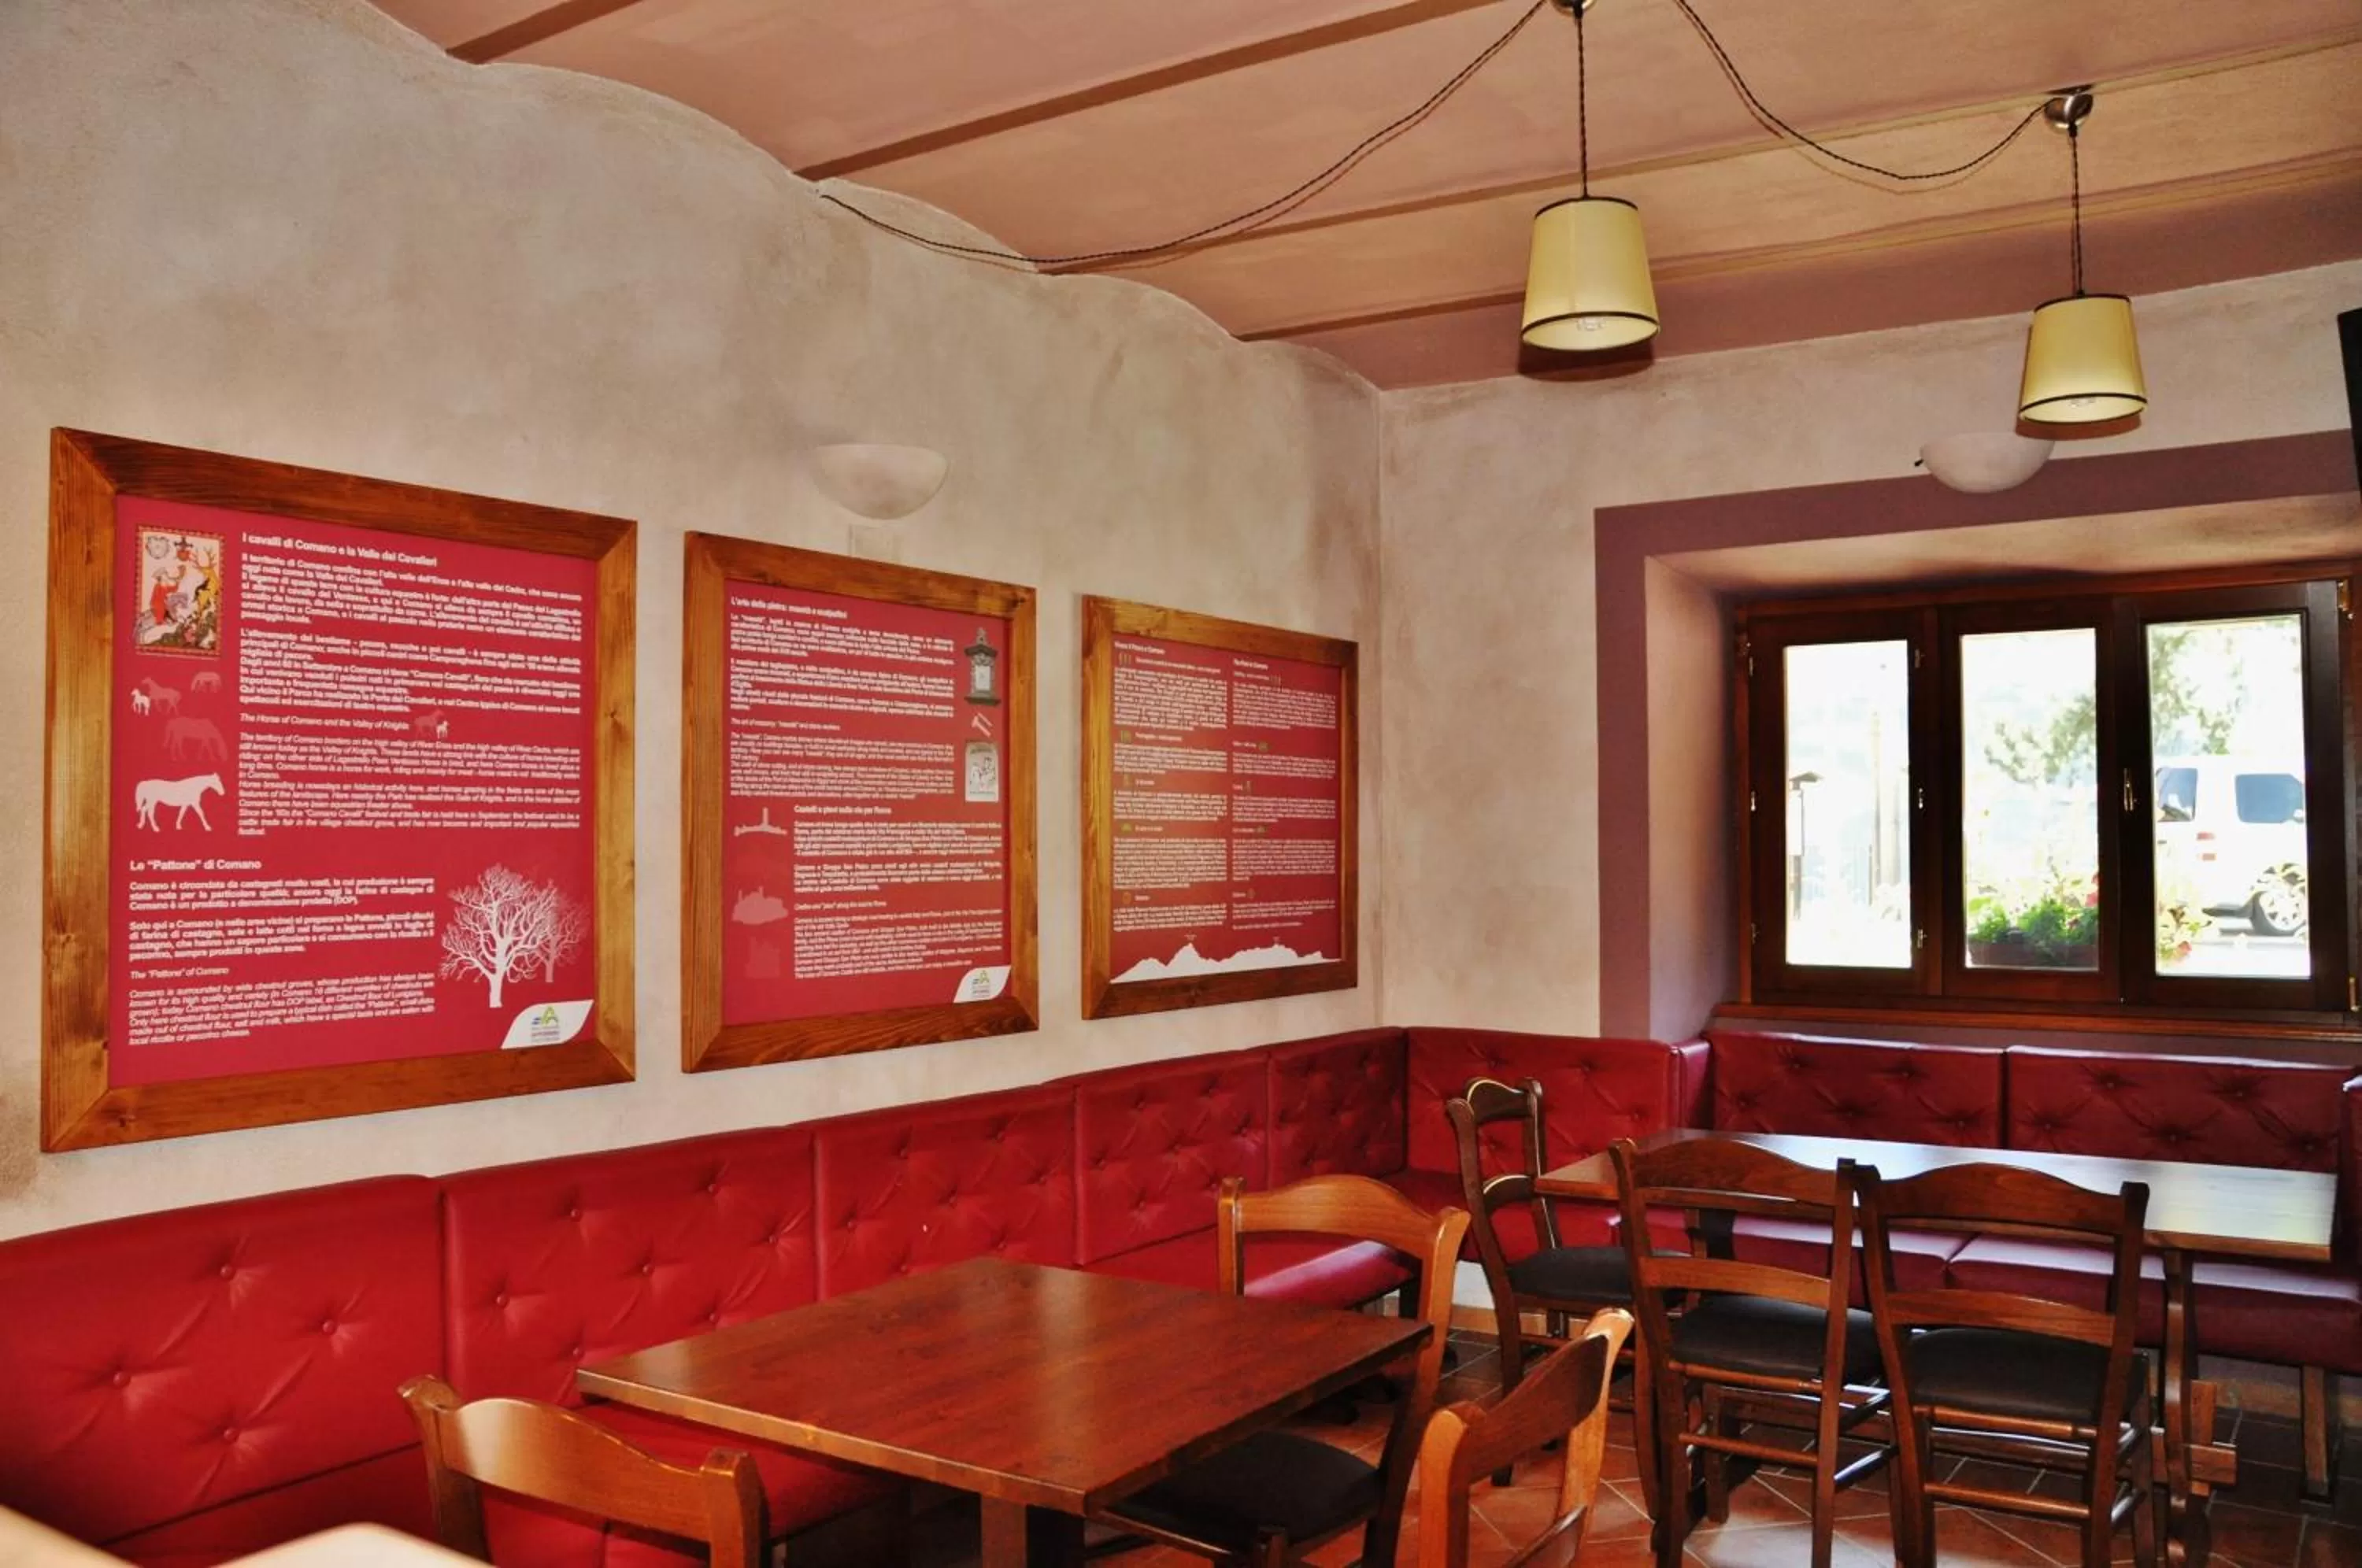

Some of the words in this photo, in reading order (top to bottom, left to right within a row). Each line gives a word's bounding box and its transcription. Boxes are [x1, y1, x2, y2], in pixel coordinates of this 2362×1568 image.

[294, 540, 337, 554] Comano
[290, 716, 324, 725] Comano
[129, 860, 145, 870] Le
[203, 860, 215, 869] di
[216, 860, 261, 869] Comano
[194, 966, 229, 975] Comano
